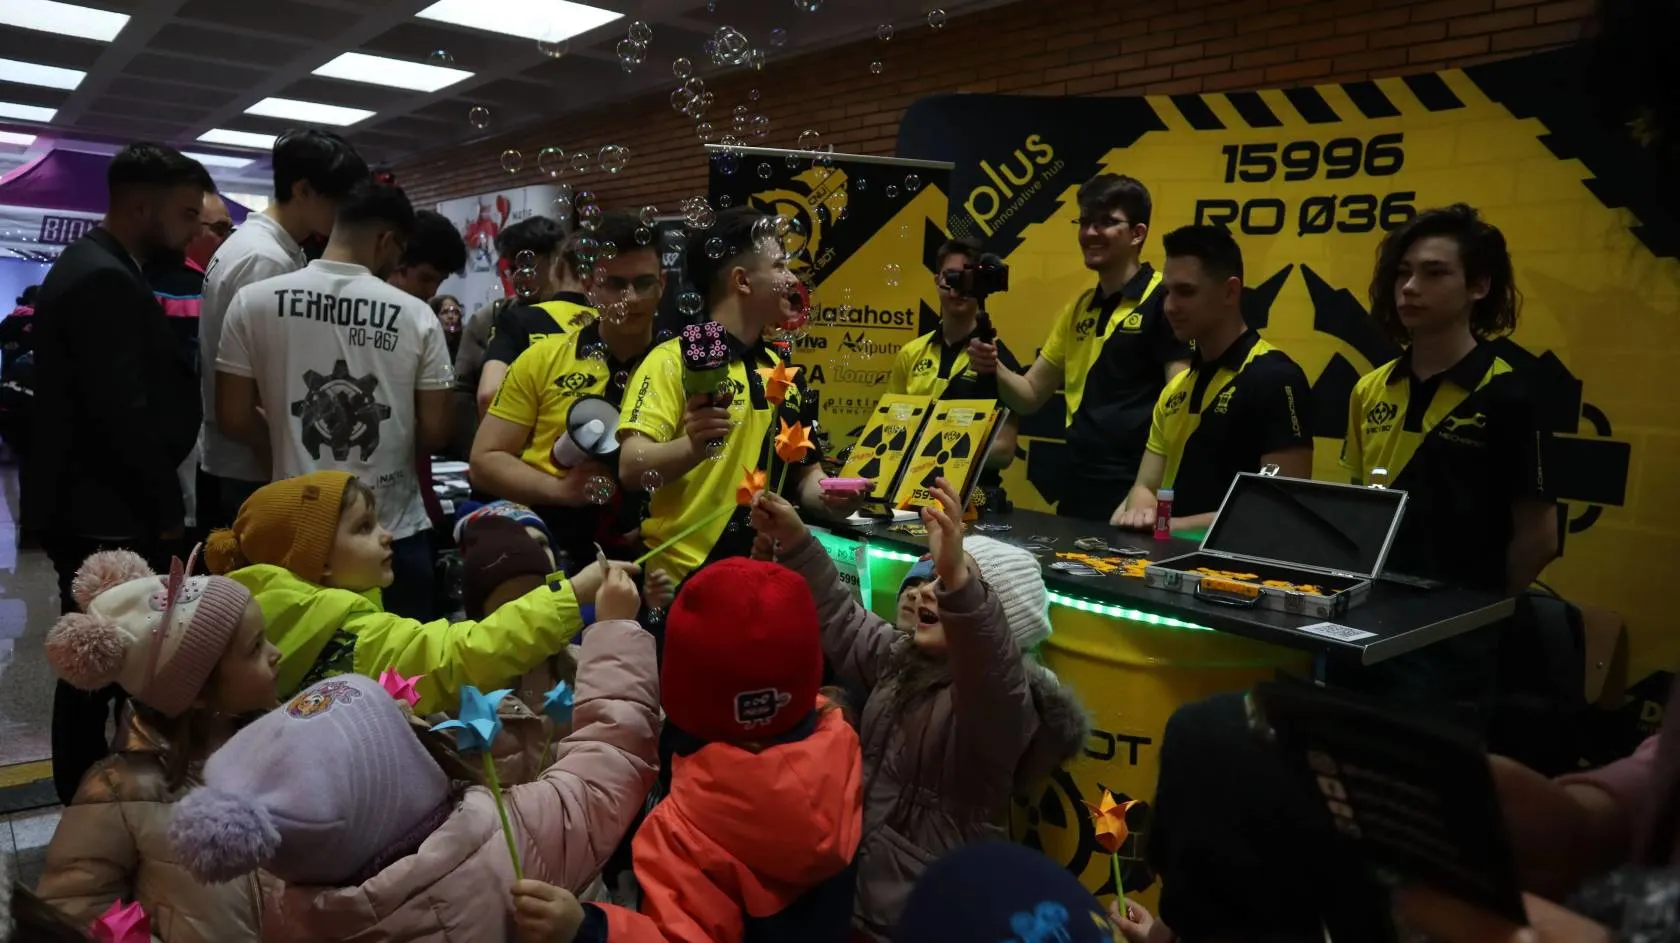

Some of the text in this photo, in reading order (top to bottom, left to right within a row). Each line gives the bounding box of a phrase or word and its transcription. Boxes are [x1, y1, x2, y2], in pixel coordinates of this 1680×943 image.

[1041, 158, 1066, 182] hub
[1222, 132, 1404, 183] 15996
[963, 133, 1055, 238] plus
[1194, 198, 1286, 236] RO
[274, 288, 402, 333] TEHROCUZ
[348, 327, 399, 353] RO-067
